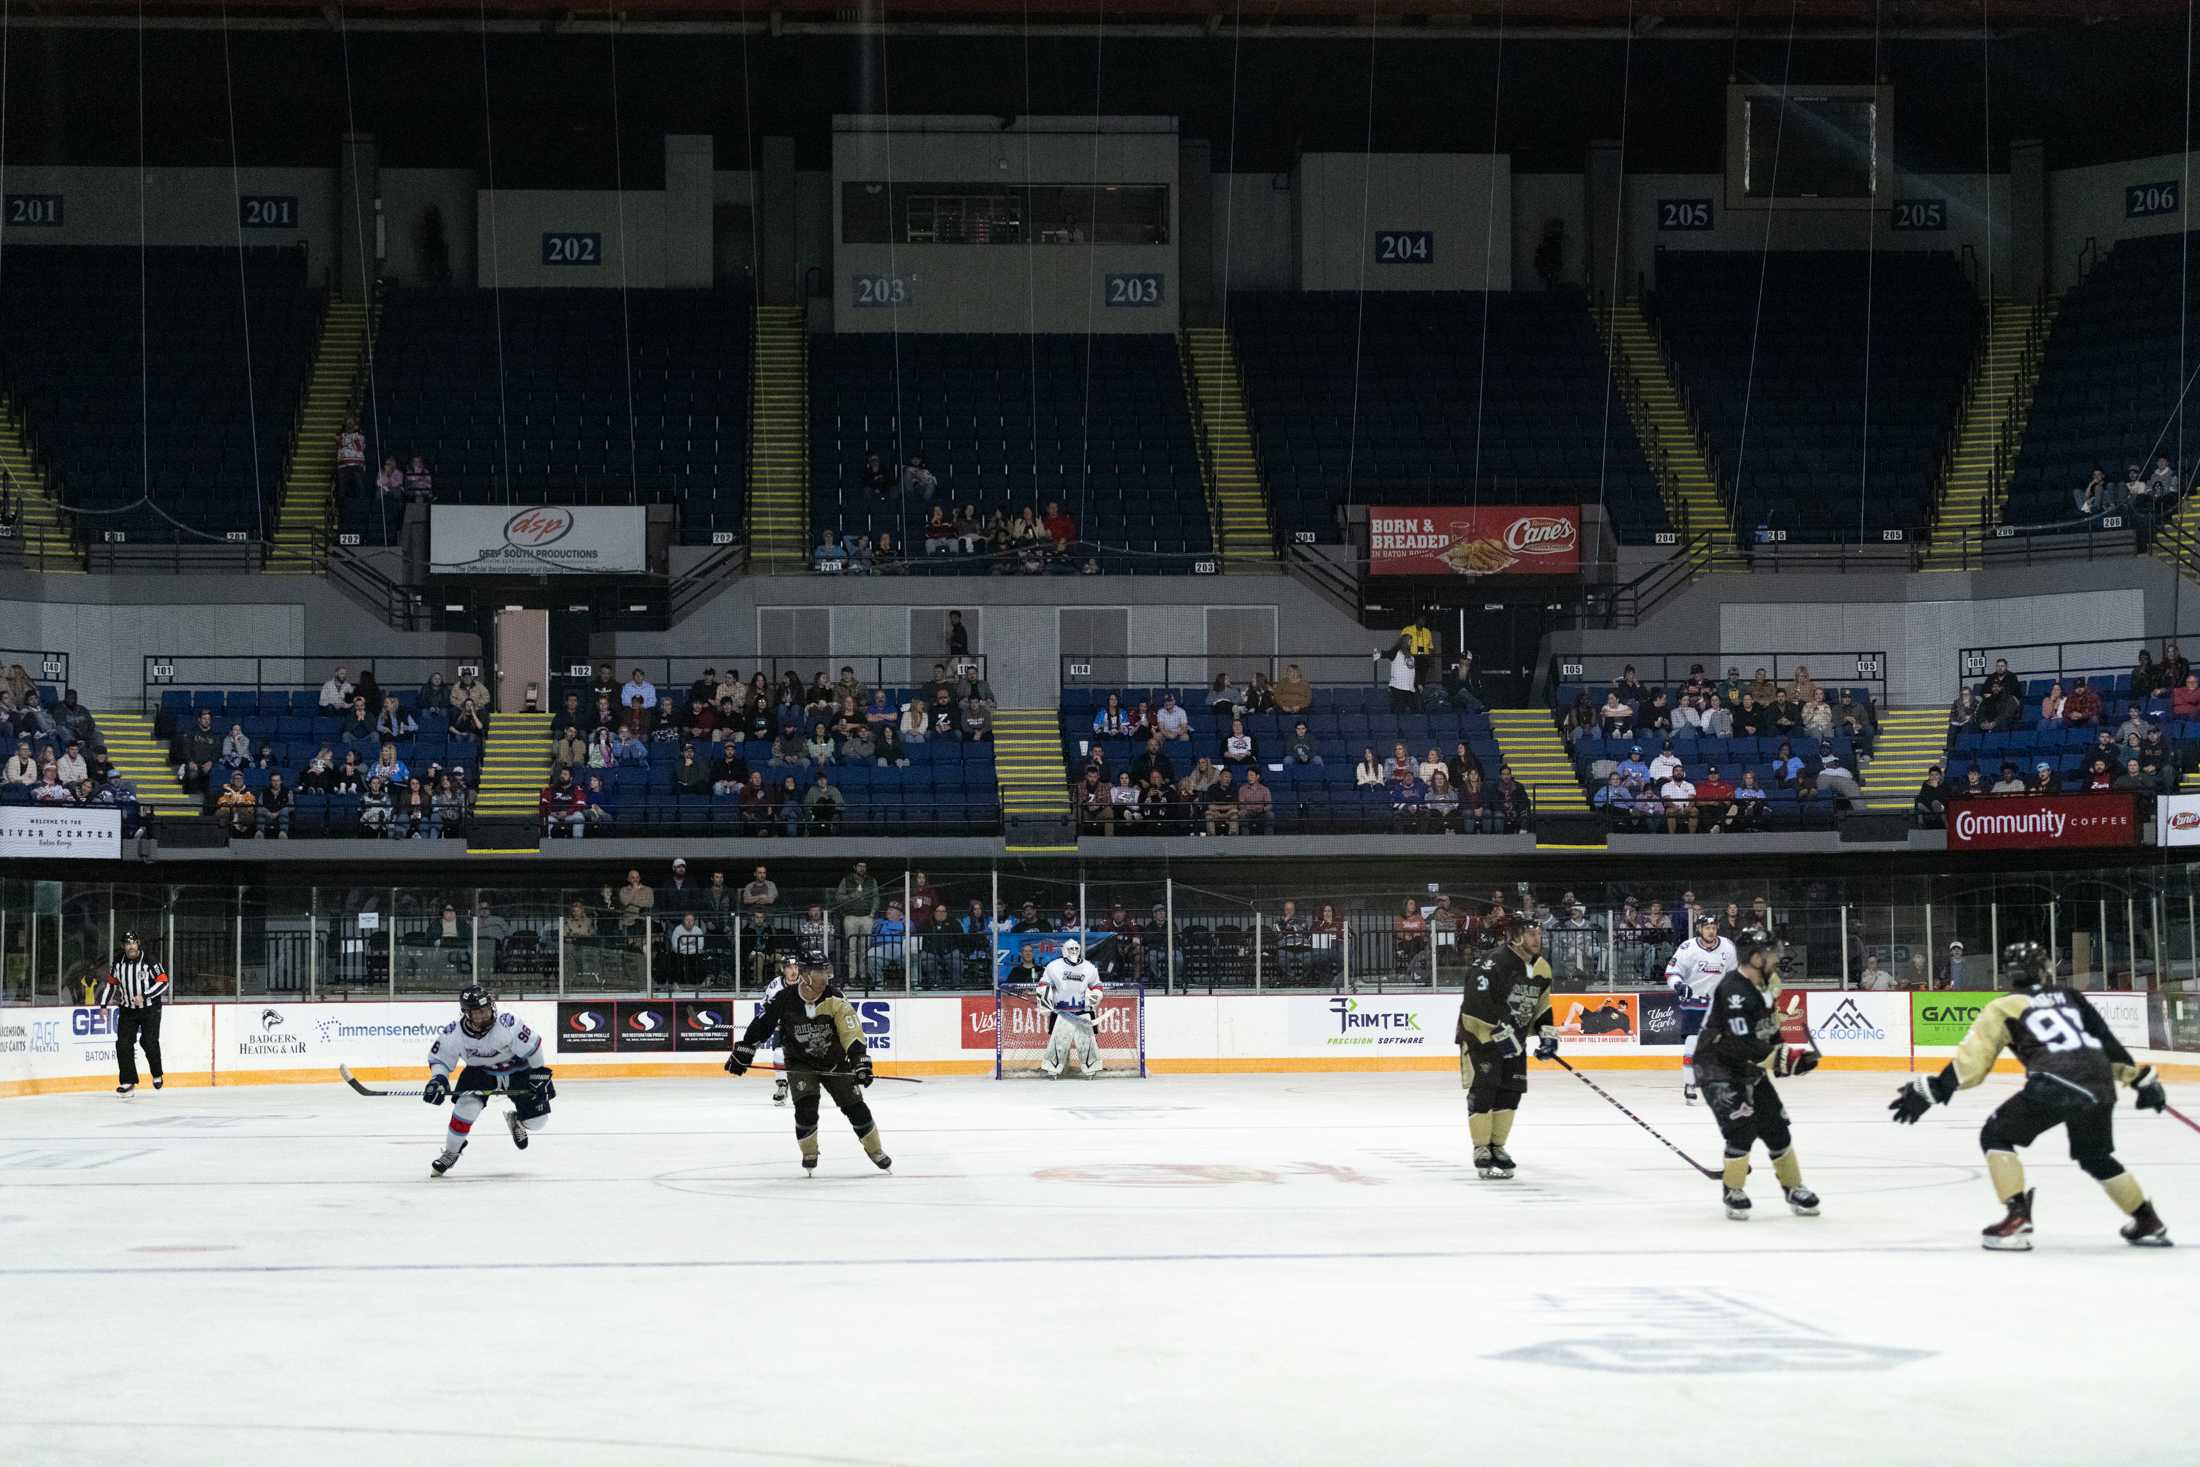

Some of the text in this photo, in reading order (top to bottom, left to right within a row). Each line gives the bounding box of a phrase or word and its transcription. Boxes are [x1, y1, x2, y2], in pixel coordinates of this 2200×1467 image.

[2133, 186, 2174, 212] 206
[13, 200, 55, 222] 201
[247, 200, 289, 223] 201
[1663, 204, 1709, 226] 205
[1896, 204, 1941, 227] 205
[549, 238, 595, 260] 202
[1381, 235, 1428, 260] 204
[859, 278, 905, 303] 203
[1111, 278, 1158, 302] 203
[1372, 519, 1435, 533] BORN &
[1506, 517, 1573, 551] Cane's
[1885, 531, 1901, 540] 205
[1372, 534, 1450, 549] BREADED
[503, 550, 534, 559] SOUTH
[536, 550, 599, 559] PRODUCTIONS
[156, 666, 171, 675] 101
[572, 666, 589, 675] 102
[1072, 665, 1088, 675] 104
[1565, 665, 1581, 674] 105
[1860, 662, 1875, 670] 105
[1956, 808, 2128, 841] Community COFFEE
[57, 830, 113, 838] CENTER
[969, 1011, 999, 1032] Visi
[1013, 1007, 1049, 1033] BAT
[1648, 1006, 1674, 1020] Uncle
[1922, 1006, 1982, 1022] GATO
[73, 1008, 119, 1036] GEI
[1648, 1017, 1676, 1033] Earl's
[338, 1023, 445, 1037] immensenetwo
[1830, 1029, 1885, 1041] ROOFING
[249, 1034, 297, 1044] BADGERS
[1378, 1036, 1425, 1044] SOFTWARE
[86, 1050, 112, 1062] BATON
[280, 1045, 288, 1054] &
